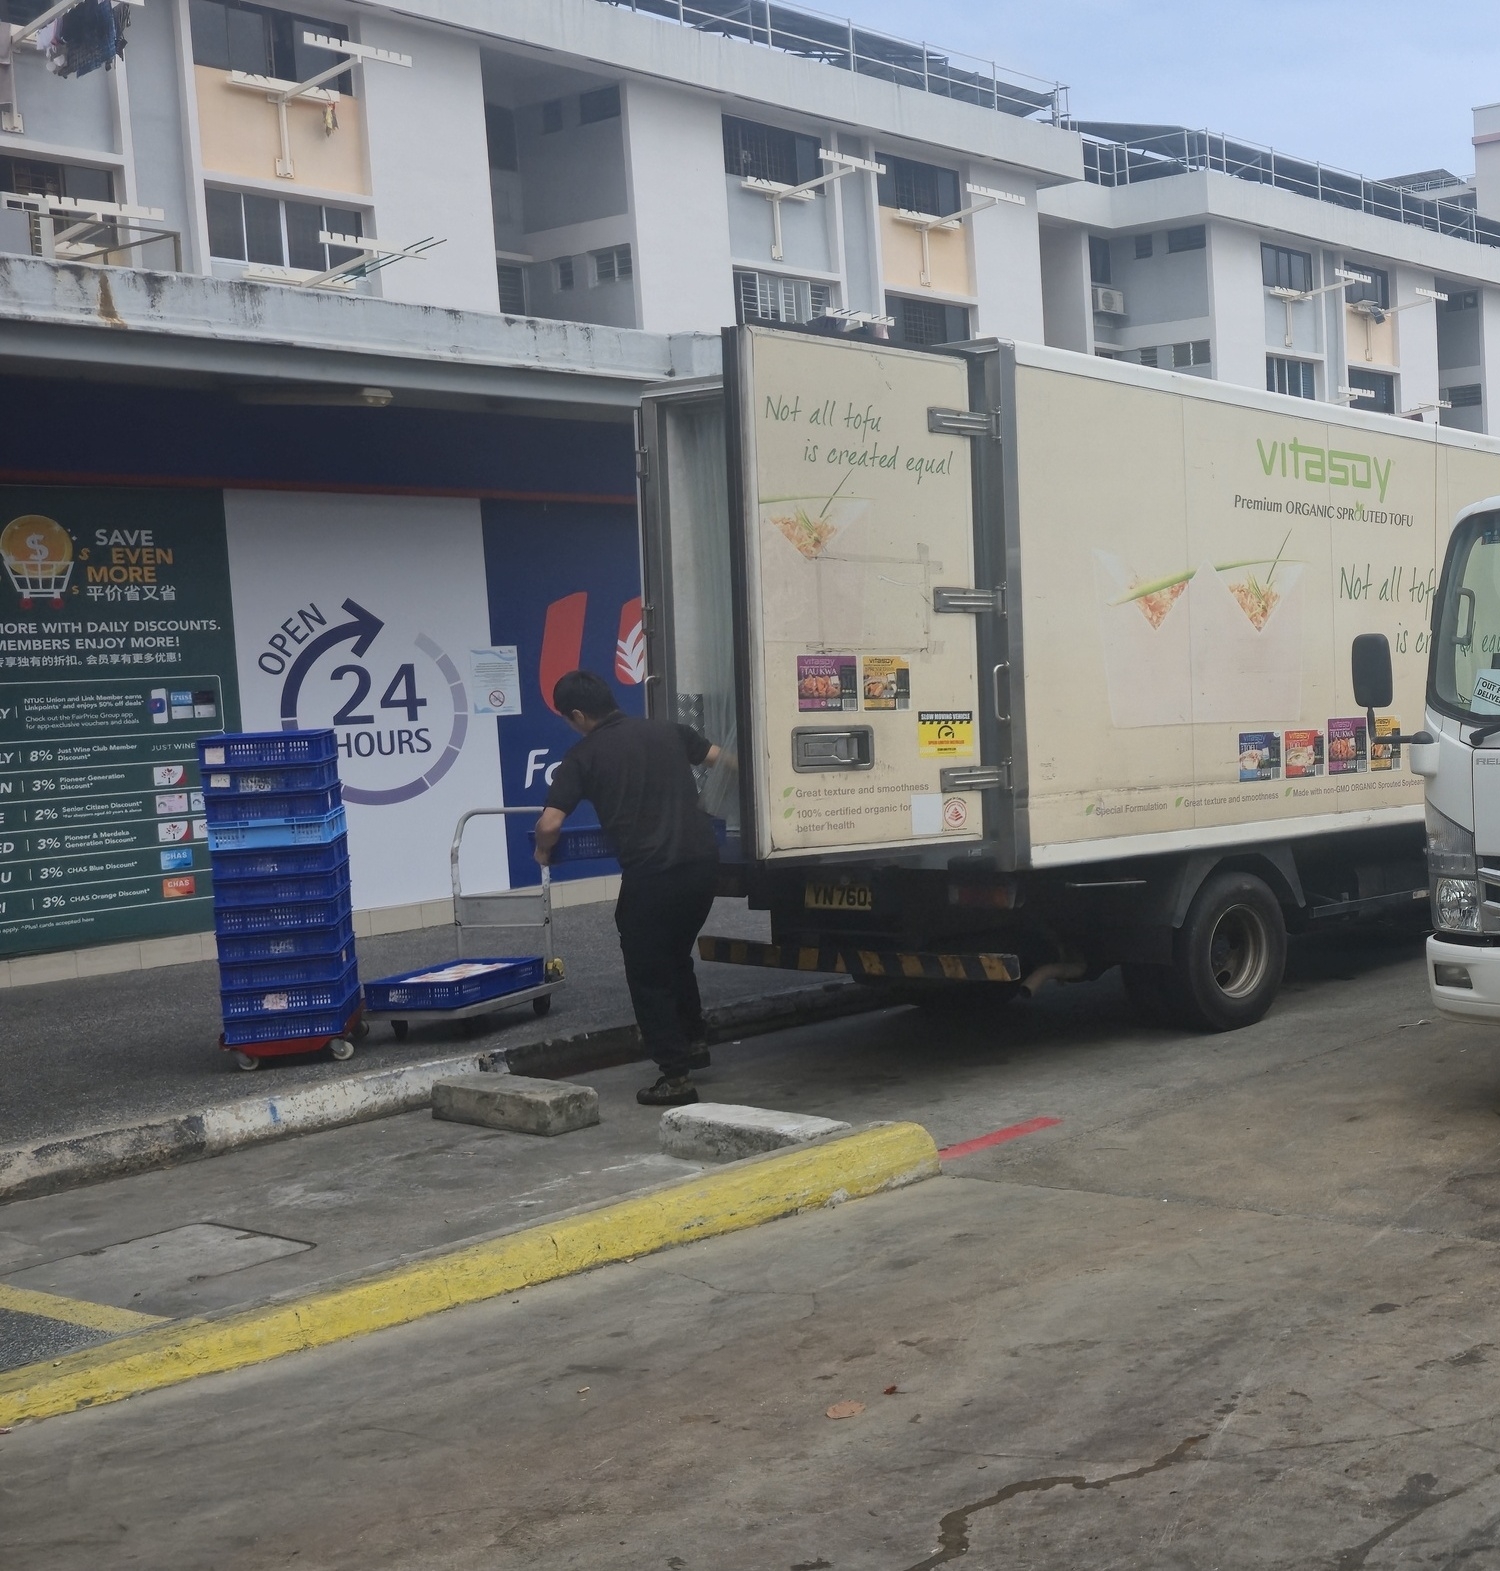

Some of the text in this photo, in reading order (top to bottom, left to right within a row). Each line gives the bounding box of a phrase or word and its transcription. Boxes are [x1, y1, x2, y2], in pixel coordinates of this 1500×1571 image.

[765, 395, 881, 442] Not all tofu
[804, 439, 953, 484] is created equal
[1256, 436, 1391, 504] vitasoy
[1234, 494, 1414, 527] Premium ORGANIC SPROUTED TOFU
[95, 529, 154, 546] SAVE
[112, 548, 173, 565] EVEN
[87, 566, 157, 583] MORE
[86, 585, 176, 601] 平价省又省
[1340, 563, 1436, 621] Not all tof
[0, 619, 222, 634] ORE WITH DAILY DISCOUNTS.
[75, 638, 126, 650] ENJOY
[131, 636, 180, 648] MORE!
[258, 602, 327, 676] OPEN
[1396, 622, 1409, 654] is
[1481, 680, 1496, 692] OUT
[330, 664, 427, 726] 24
[77, 702, 98, 710] enjoys
[98, 700, 114, 708] 50%
[25, 714, 45, 722] Check
[100, 712, 119, 721] Group
[120, 712, 134, 720] app
[151, 742, 196, 752] JUST WINE
[336, 727, 432, 758] HOURS
[30, 749, 53, 762] 8%
[57, 747, 73, 755] Just
[75, 746, 92, 754] Wine
[87, 773, 126, 781] Generation
[32, 778, 56, 792] 3%
[796, 783, 929, 798] Great texture and smoothness
[1293, 787, 1310, 797] Made
[1310, 786, 1323, 796] with
[1323, 785, 1350, 795] non-GMO
[1351, 782, 1377, 792] ORGANIC
[1378, 780, 1401, 791] Sprouted
[1184, 792, 1279, 808] Great texture and smoothness
[35, 807, 58, 821] 2%
[62, 804, 84, 813] Senior
[85, 803, 109, 811] Citizen
[796, 803, 912, 819] 100% certified organic for
[1095, 801, 1168, 817] Special Formulation
[796, 820, 855, 834] better health
[64, 833, 92, 842] Pioneer
[100, 830, 130, 838] Merdeka
[38, 837, 61, 850] 3%
[65, 840, 103, 849] Generation
[165, 851, 188, 860] CHAS
[40, 866, 63, 879] 3%
[67, 866, 88, 874] CHAS
[89, 864, 104, 872] Blue
[167, 879, 190, 888] CHAS
[42, 895, 66, 909] 3%
[70, 895, 90, 903] CHAS
[91, 891, 117, 902] Orange
[55, 918, 81, 927] accepted
